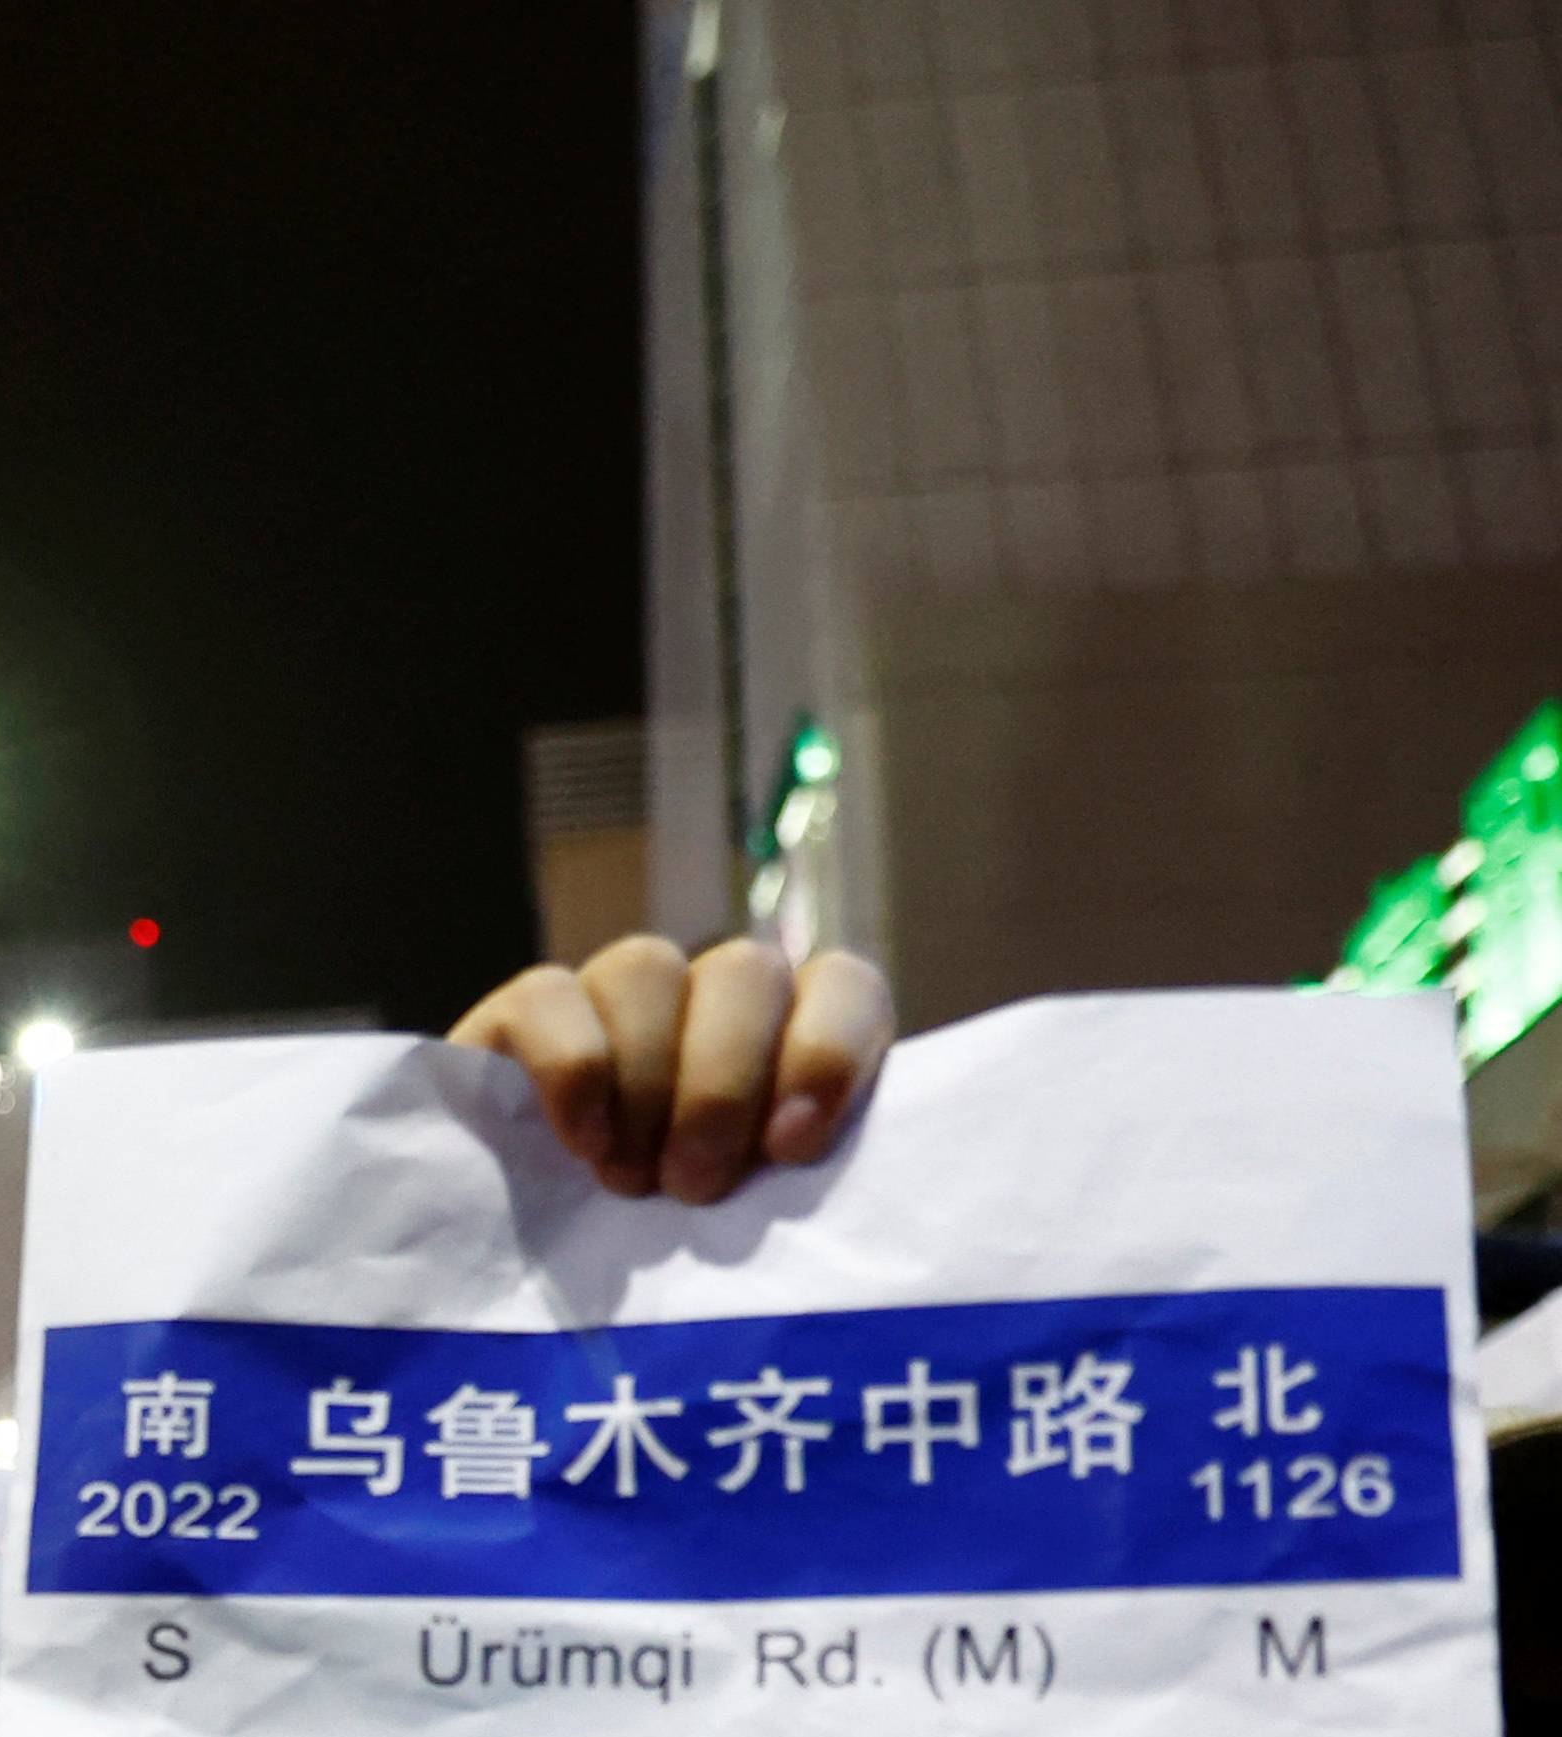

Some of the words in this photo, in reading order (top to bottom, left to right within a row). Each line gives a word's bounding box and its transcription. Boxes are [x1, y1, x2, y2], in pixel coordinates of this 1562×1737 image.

[120, 1370, 215, 1458] 南
[289, 1350, 1145, 1501] 乌鲁木齐中路
[1212, 1343, 1323, 1437] 北
[76, 1480, 261, 1540] 2022
[1190, 1453, 1396, 1522] 1126
[142, 1621, 193, 1683] S
[418, 1612, 696, 1704] Ürümqi
[754, 1626, 885, 1692] Rd.
[920, 1622, 1057, 1702] (M)
[1255, 1615, 1327, 1679] M
